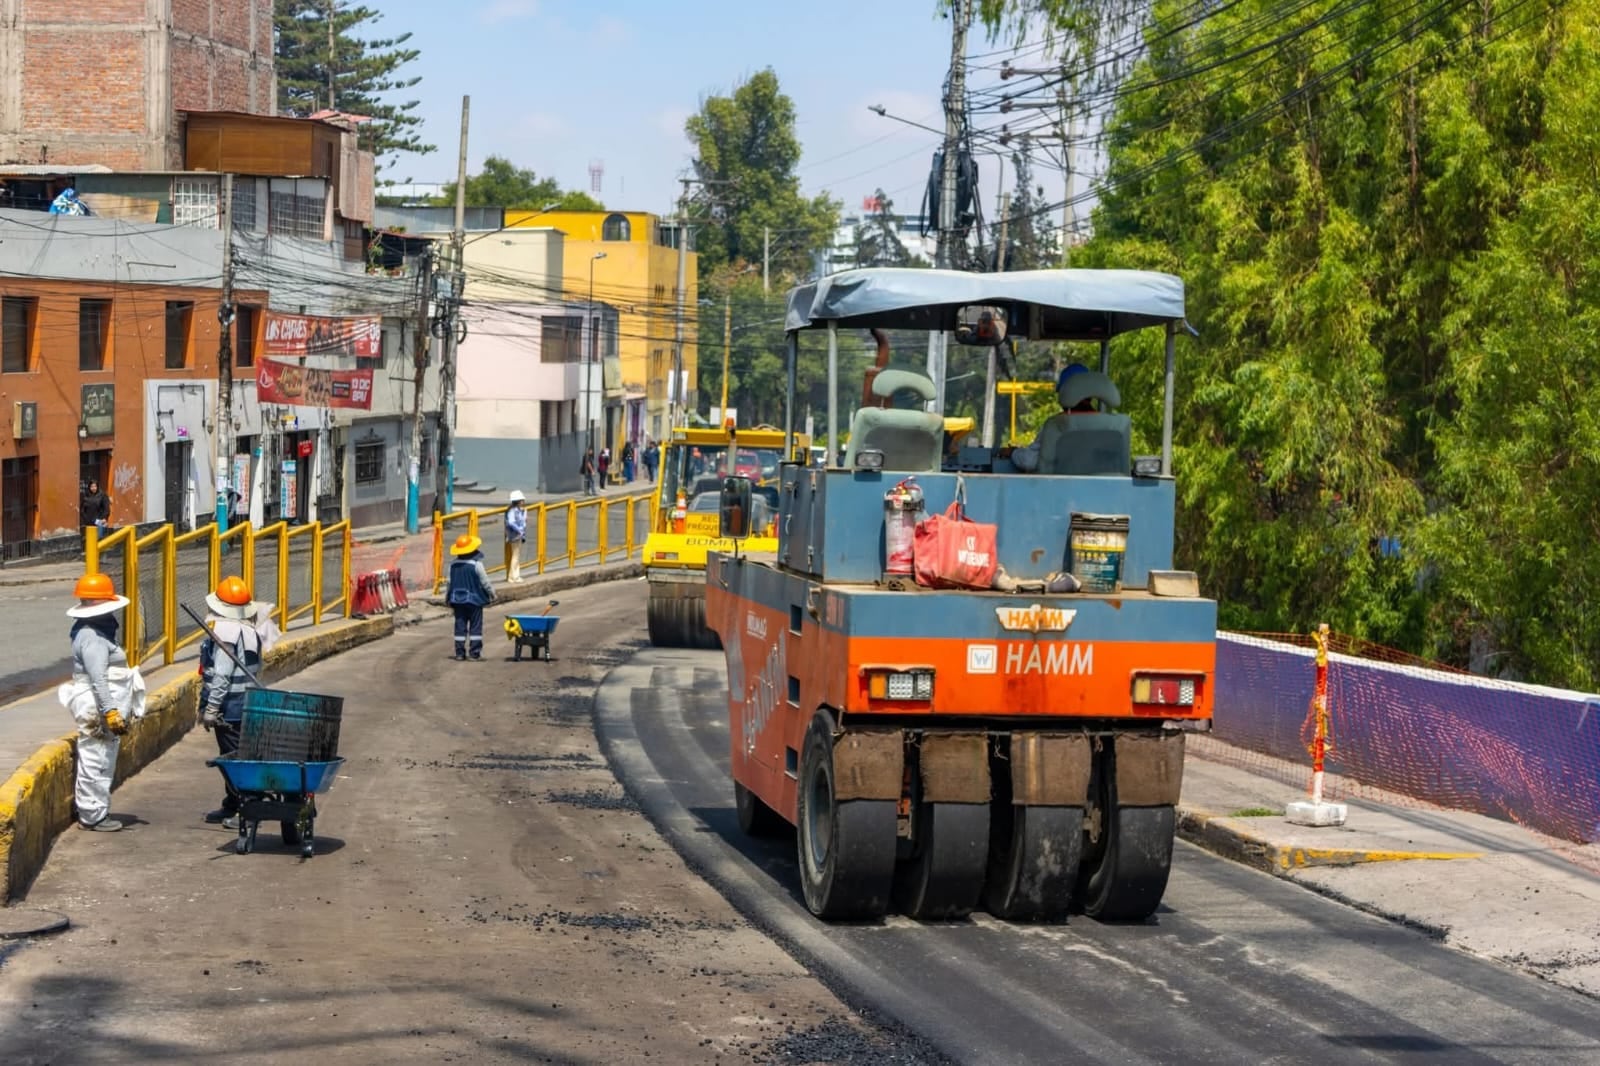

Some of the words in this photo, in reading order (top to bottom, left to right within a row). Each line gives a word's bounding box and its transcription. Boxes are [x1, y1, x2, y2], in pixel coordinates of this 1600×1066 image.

[265, 319, 280, 340] LOS
[1008, 610, 1065, 628] HAMM
[1005, 643, 1094, 676] HAMM
